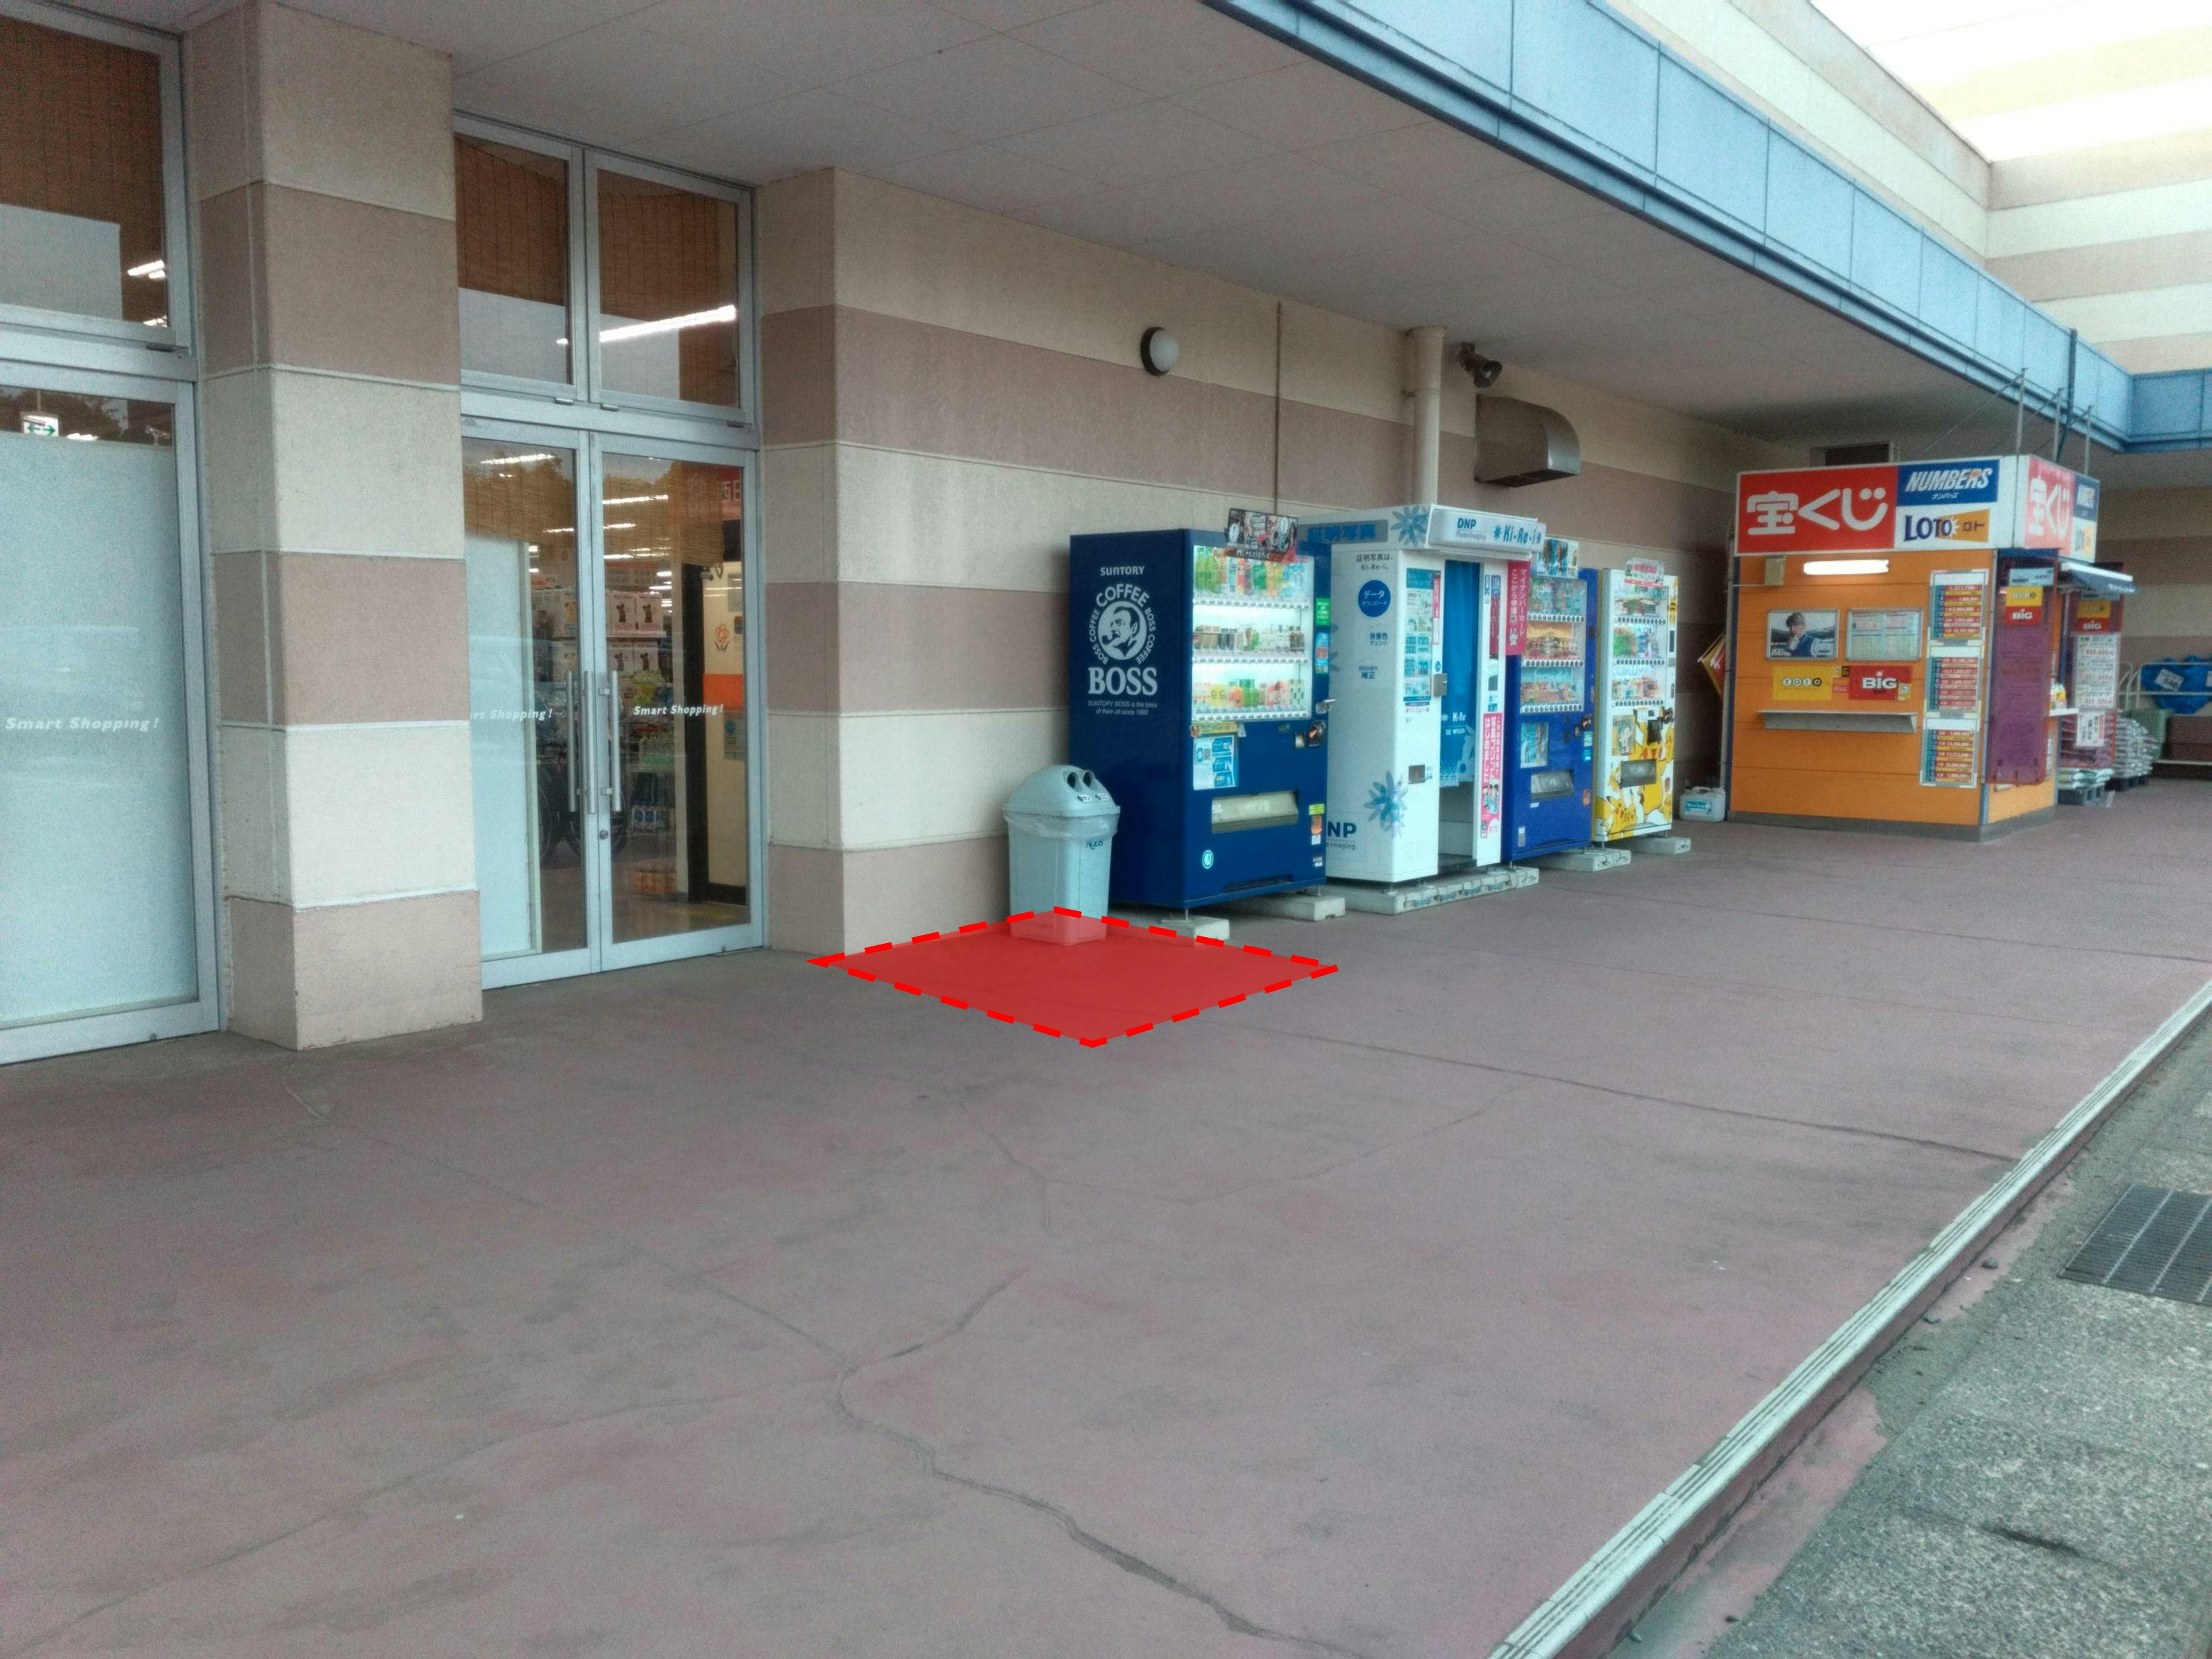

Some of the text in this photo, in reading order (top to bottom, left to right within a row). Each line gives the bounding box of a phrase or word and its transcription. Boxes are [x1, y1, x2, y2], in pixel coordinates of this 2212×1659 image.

[1905, 467, 1993, 492] NUMBERS
[1746, 487, 1888, 536] 宝くじ
[1457, 517, 1477, 530] DNP
[1904, 514, 1953, 542] LOTO
[1100, 566, 1146, 576] SUNTORY
[1096, 583, 1150, 608] COFFEE
[1363, 590, 1386, 599] データ
[1088, 666, 1158, 696] BOSS
[1782, 677, 1822, 687] toto
[633, 705, 668, 716] Smart
[5, 717, 63, 730] Smart
[1327, 821, 1357, 839] NP
